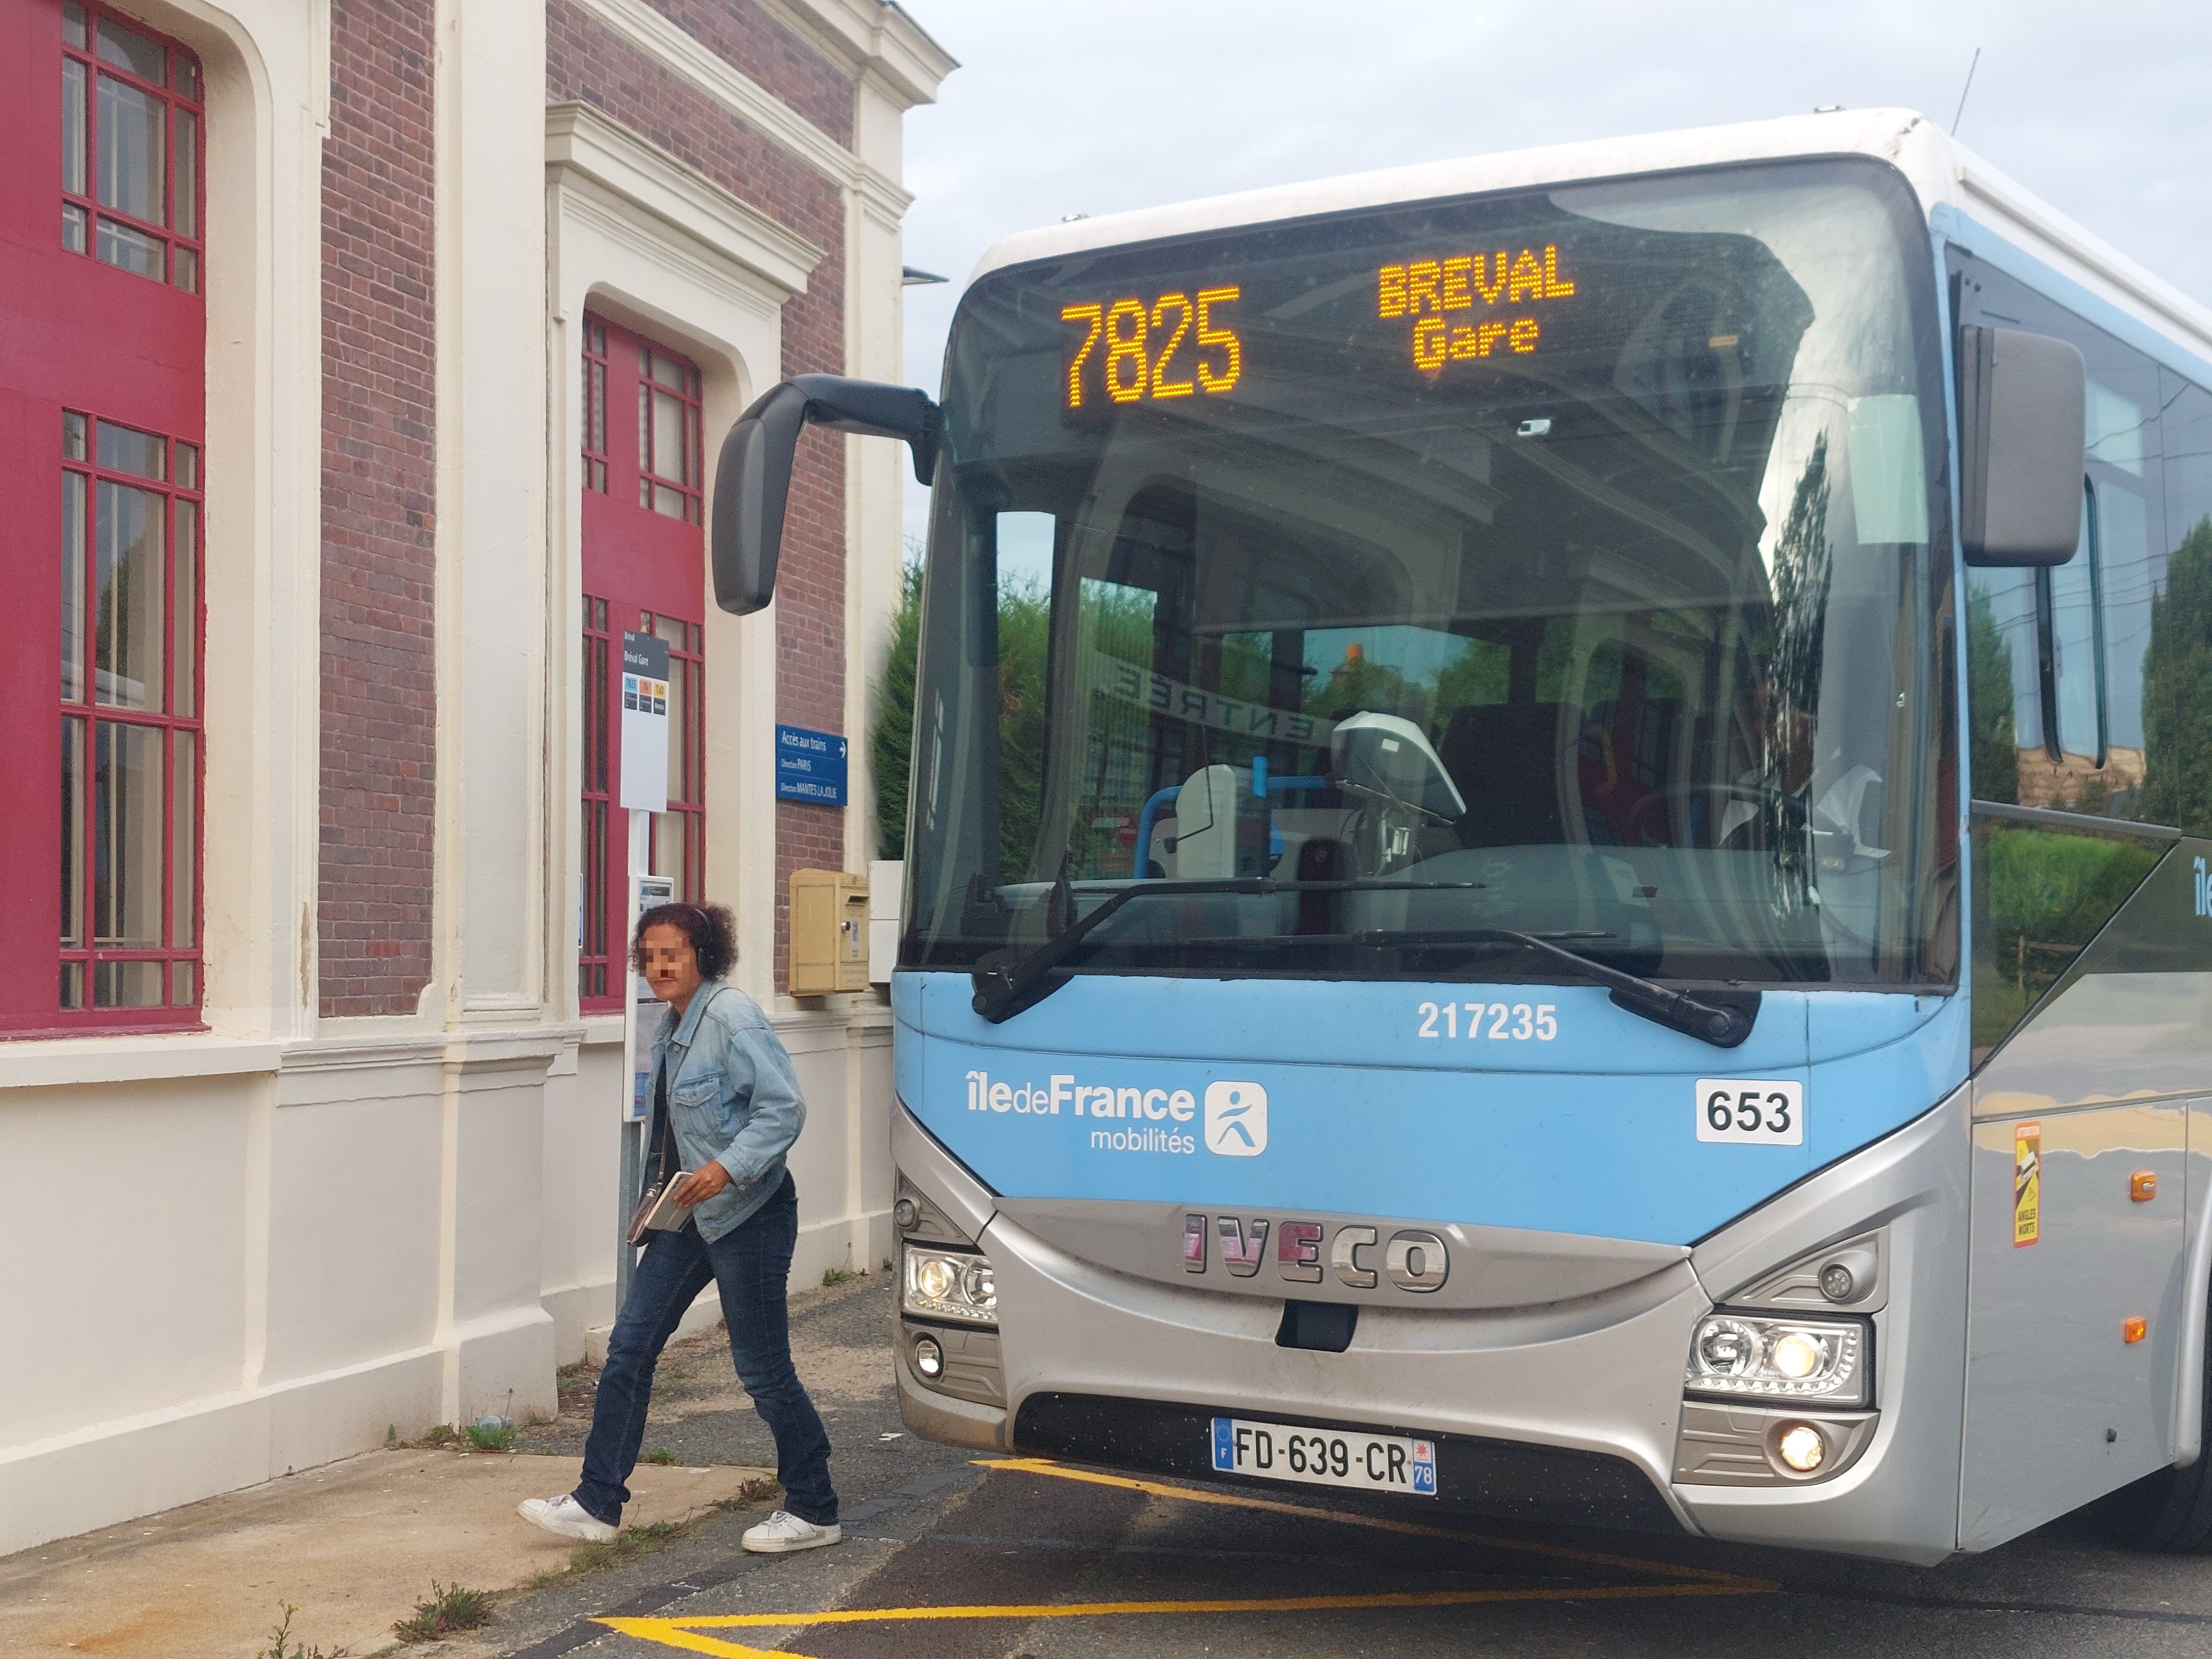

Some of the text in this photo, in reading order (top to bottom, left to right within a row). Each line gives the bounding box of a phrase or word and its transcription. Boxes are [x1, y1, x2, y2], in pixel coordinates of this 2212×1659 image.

[1378, 245, 1575, 318] BREVAL
[1061, 286, 1241, 408] 7825
[1413, 317, 1539, 369] Gare
[624, 650, 649, 666] Bréval Gare
[782, 730, 826, 752] Accès aux trains
[797, 758, 811, 771] PARIS
[797, 782, 817, 795] MANTES
[817, 785, 824, 796] LA
[824, 786, 837, 798] JOLIE
[1418, 1002, 1558, 1040] 217235
[1707, 1090, 1792, 1133] 653
[1091, 1127, 1195, 1154] mobilités
[2018, 1208, 2036, 1222] ANGLES
[2019, 1223, 2035, 1236] MORTS
[1184, 1214, 1450, 1293] IVECO
[1220, 1448, 1227, 1459] F
[1236, 1427, 1407, 1484] FD-639-CR
[1415, 1465, 1431, 1484] 78
